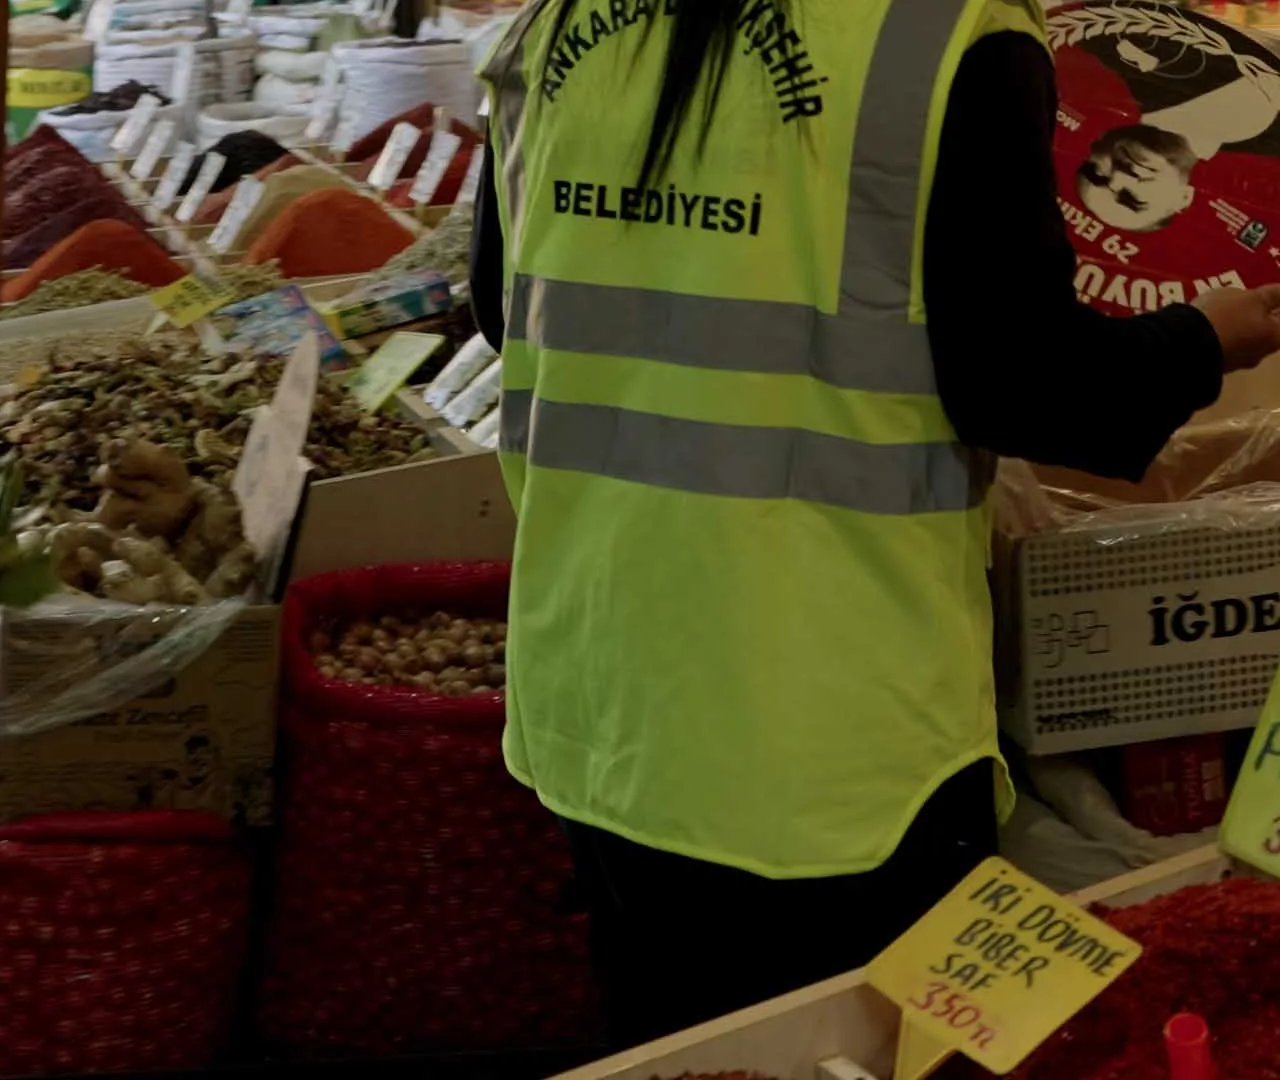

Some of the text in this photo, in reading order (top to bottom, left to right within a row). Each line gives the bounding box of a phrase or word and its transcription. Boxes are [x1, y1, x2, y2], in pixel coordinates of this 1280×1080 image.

[554, 180, 762, 237] BELEDİYESİ
[1102, 233, 1139, 265] 29
[1072, 253, 1186, 316] BÜYÜ
[954, 917, 1051, 990] BİBER
[968, 869, 1126, 979] İRİ DÖVME
[929, 952, 998, 992] SAF
